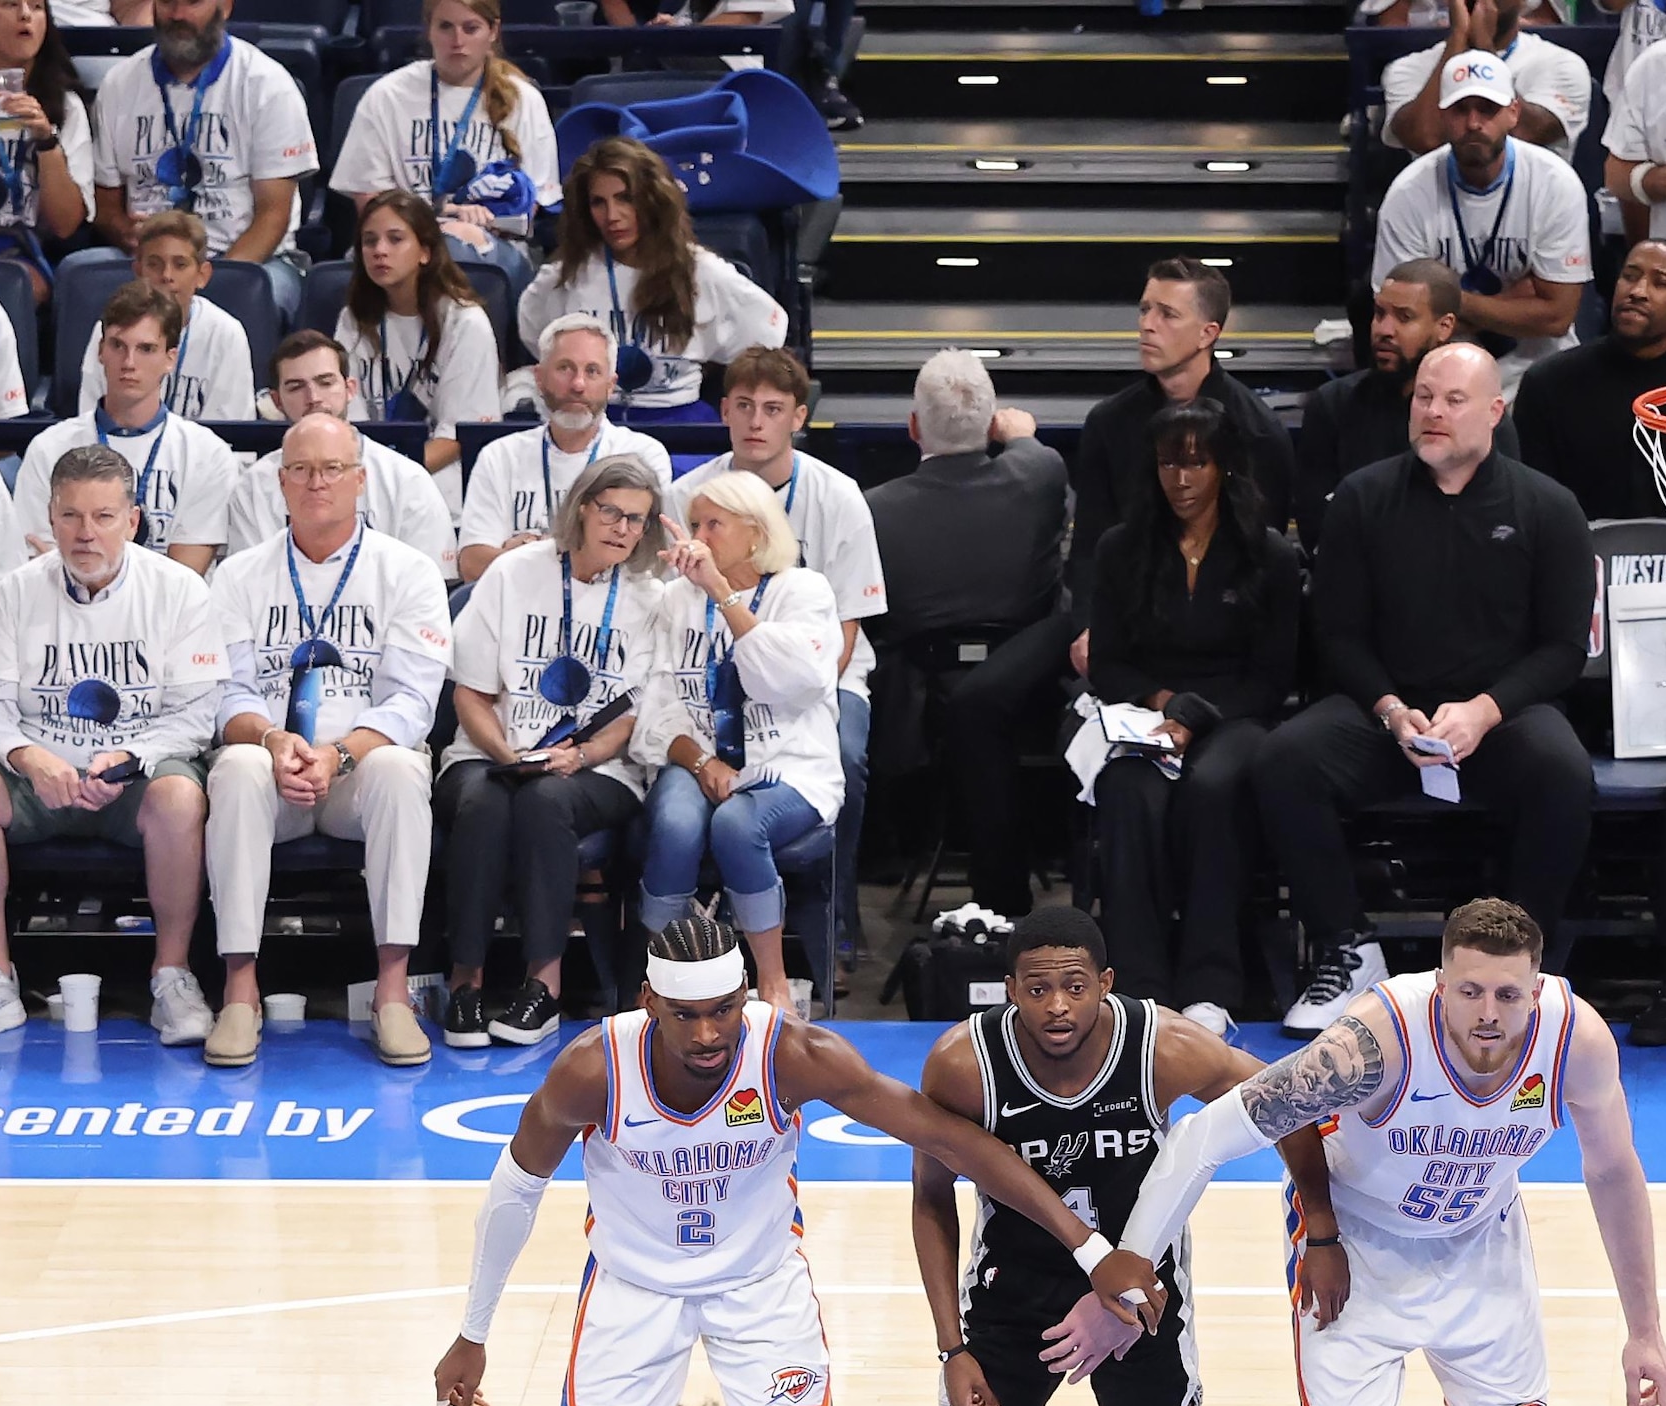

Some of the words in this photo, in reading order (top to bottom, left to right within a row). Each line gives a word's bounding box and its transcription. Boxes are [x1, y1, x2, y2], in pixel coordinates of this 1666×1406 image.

[1452, 63, 1495, 83] OKC
[522, 613, 629, 674] PLAOFFS
[38, 639, 150, 687] PLAYOFFS
[352, 657, 373, 680] 26
[519, 667, 541, 691] 20
[595, 680, 617, 705] 26
[680, 678, 699, 701] 20
[37, 694, 60, 716] 20
[131, 693, 152, 717] 26
[37, 729, 141, 747] THUND
[264, 1098, 375, 1143] by
[1098, 1100, 1133, 1114] LEDGER
[1008, 1128, 1152, 1179] PURS
[1388, 1125, 1546, 1158] OKLAHOMA
[1422, 1160, 1497, 1187] CITY
[661, 1175, 731, 1206] CITY
[1398, 1183, 1490, 1225] 55
[1061, 1186, 1101, 1231] 4
[676, 1208, 716, 1247] 2
[771, 1372, 809, 1399] OKC
